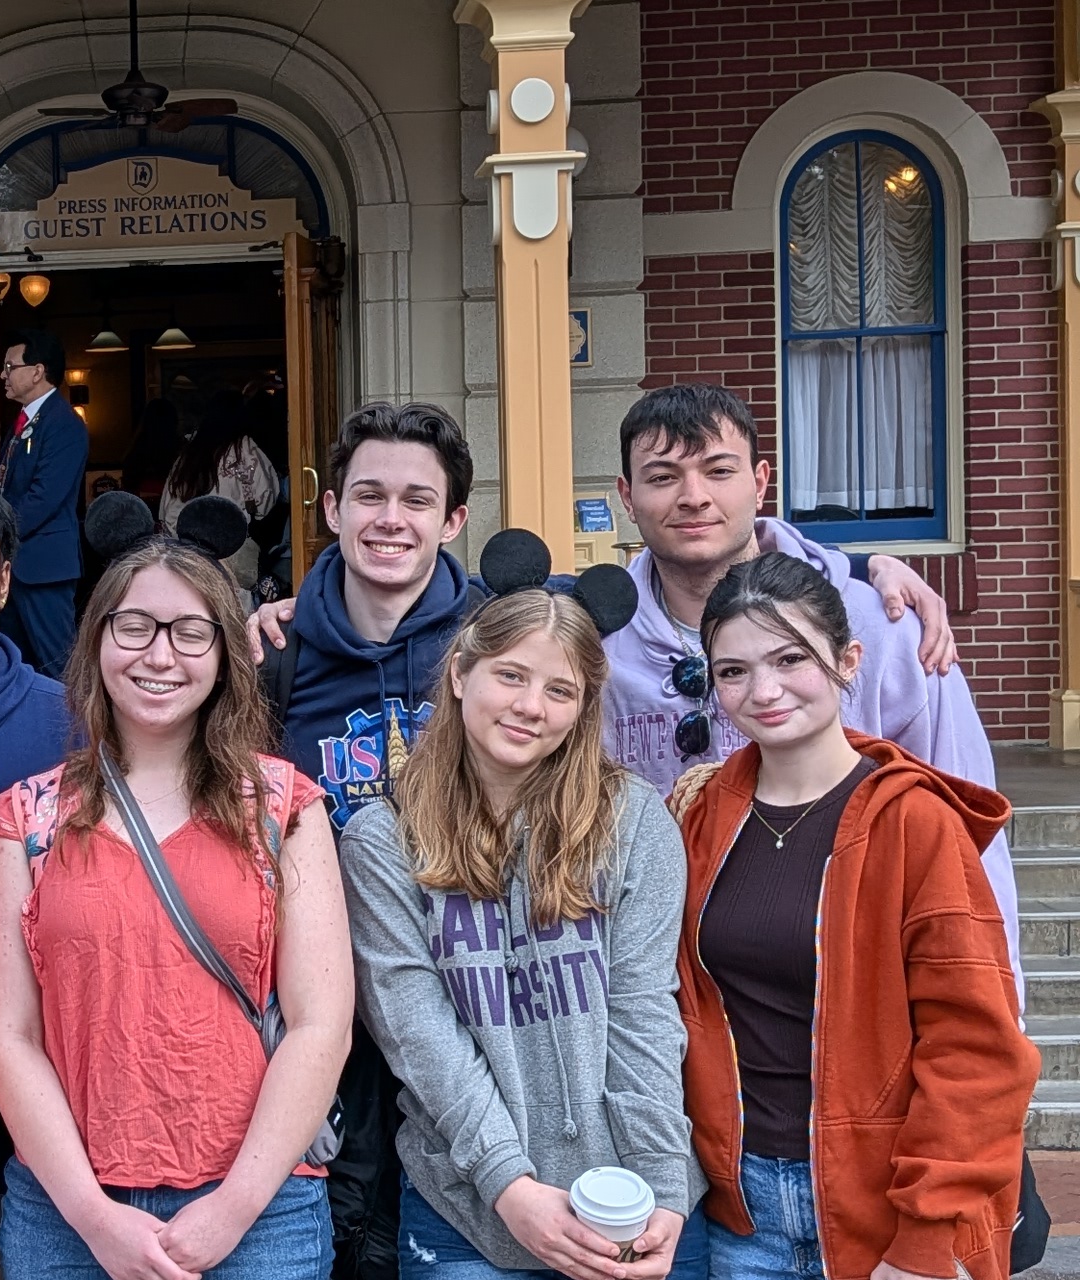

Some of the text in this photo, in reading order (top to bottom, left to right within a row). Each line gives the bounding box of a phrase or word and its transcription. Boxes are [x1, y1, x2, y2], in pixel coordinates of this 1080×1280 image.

[58, 192, 229, 215] PRESS INFORMATION
[24, 209, 267, 239] GUEST RELATIONS
